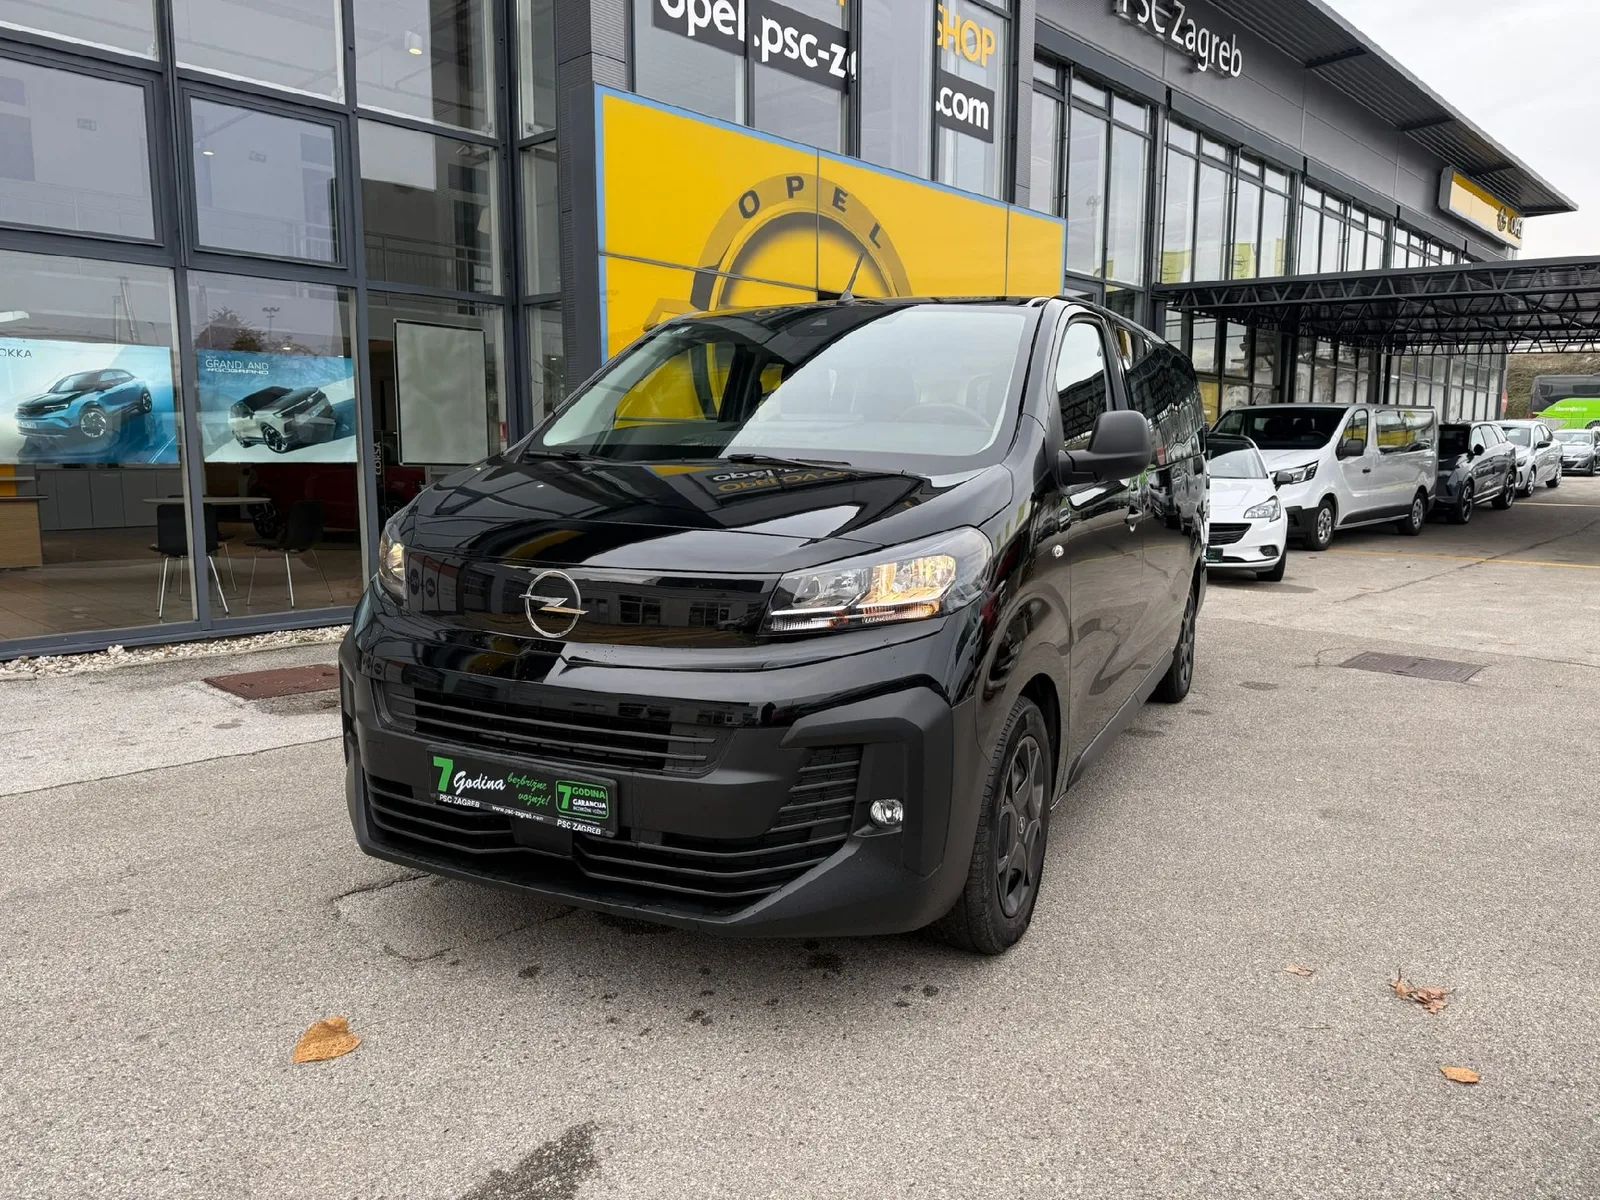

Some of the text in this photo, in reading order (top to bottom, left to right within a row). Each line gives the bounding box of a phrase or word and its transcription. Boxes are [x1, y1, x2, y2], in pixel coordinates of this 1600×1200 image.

[1171, 0, 1242, 78] Zagreb
[935, 87, 989, 130] .com
[738, 176, 881, 249] OPEL
[433, 756, 507, 795] 7 Godina
[439, 794, 480, 808] PSC ZAGREB
[558, 784, 606, 809] 7 GODINA
[491, 805, 544, 821] www.psc-zagreb.com
[557, 819, 572, 829] PSC
[572, 823, 601, 835] ZAGREB
